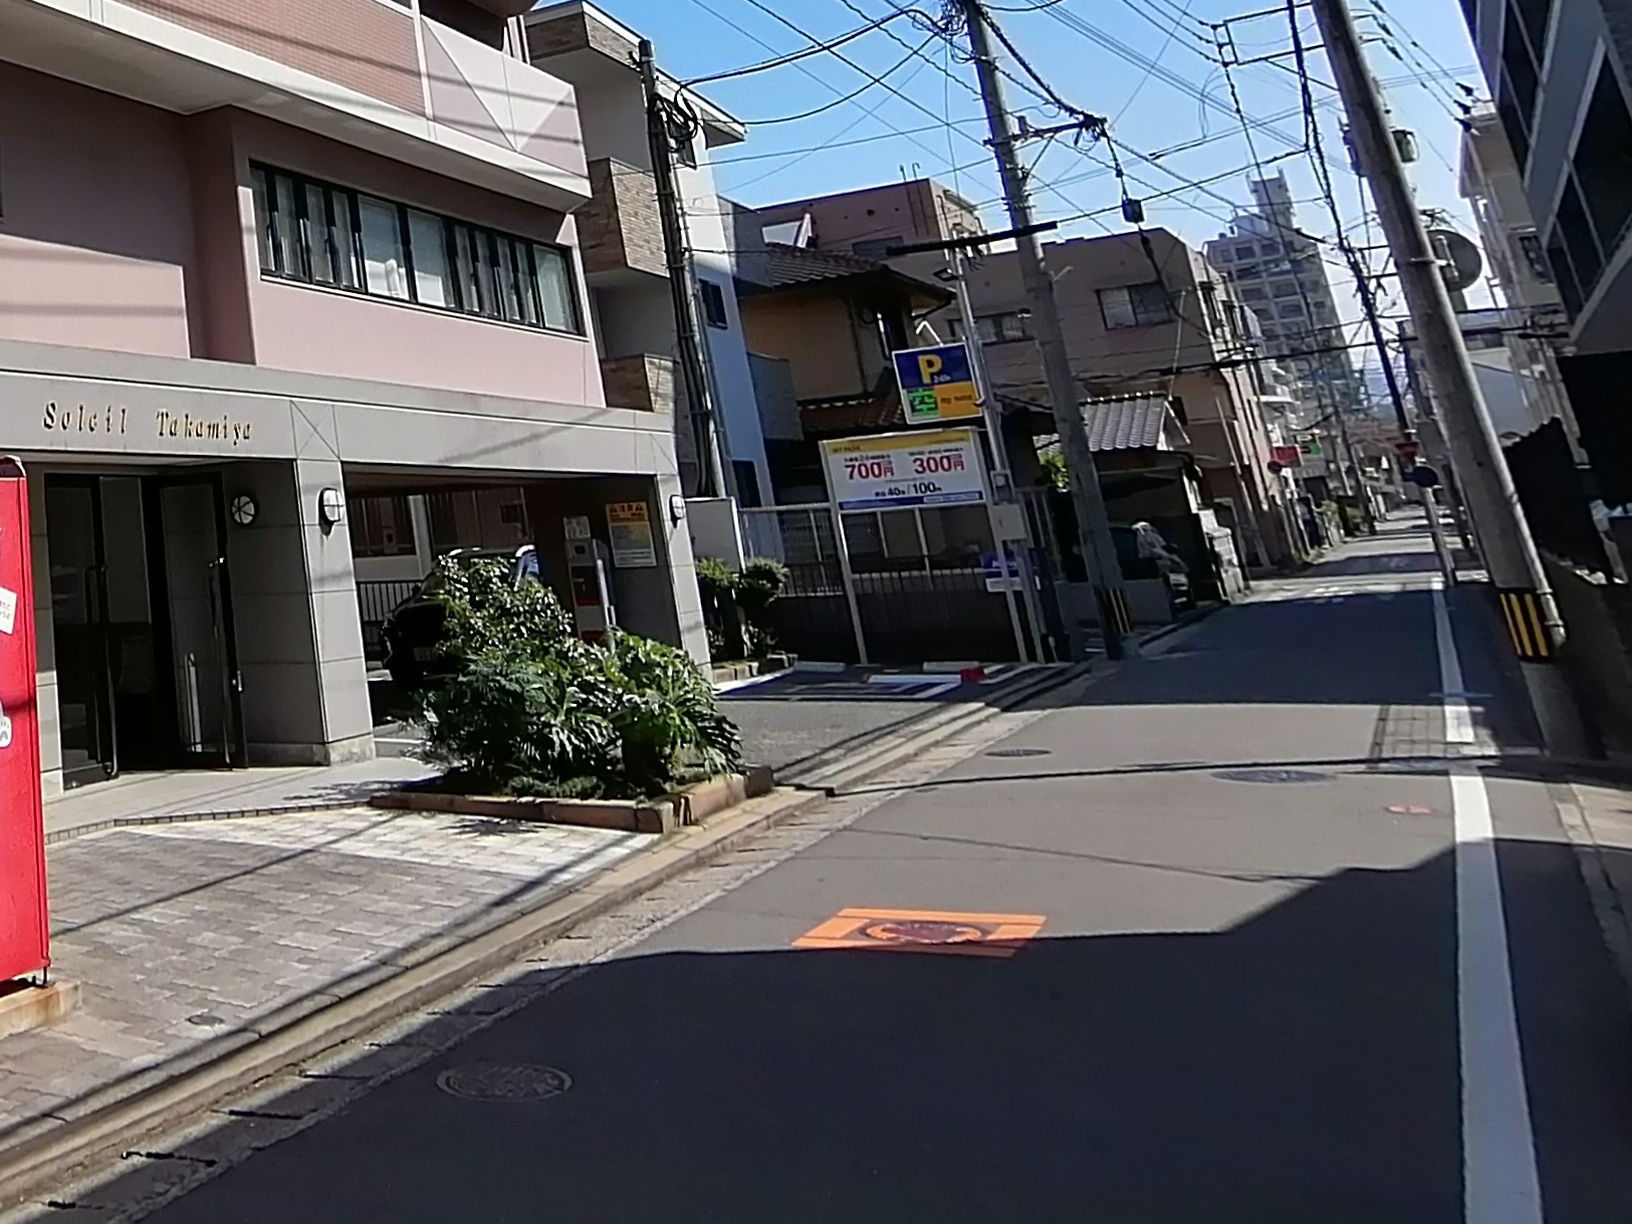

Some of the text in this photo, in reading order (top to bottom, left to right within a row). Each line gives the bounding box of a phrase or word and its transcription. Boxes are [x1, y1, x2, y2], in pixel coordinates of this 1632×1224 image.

[918, 355, 942, 384] P
[43, 402, 251, 447] Soleil Takamiya
